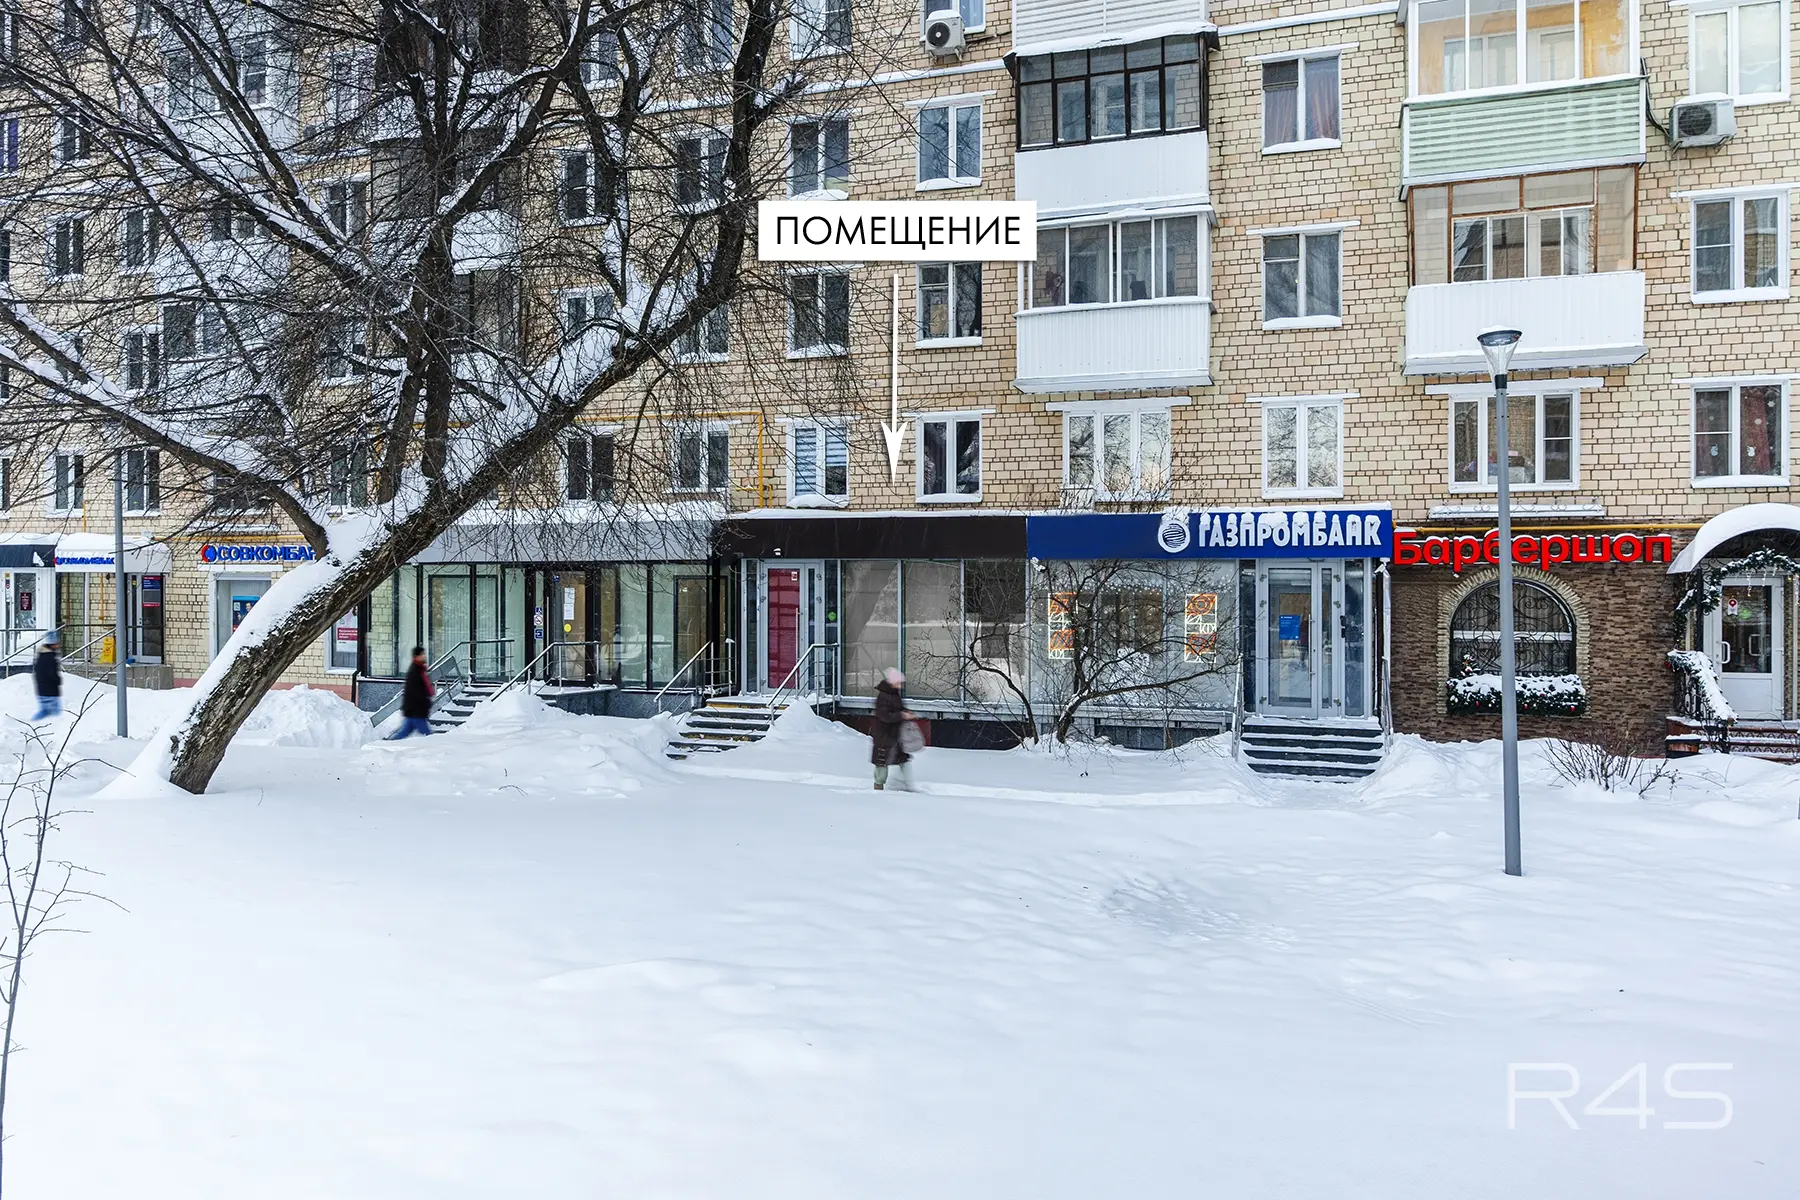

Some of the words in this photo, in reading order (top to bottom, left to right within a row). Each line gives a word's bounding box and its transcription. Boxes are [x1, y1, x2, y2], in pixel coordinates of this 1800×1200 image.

[1198, 514, 1382, 547] ГАЗПРОМБАНК
[218, 545, 317, 561] СОВКОМБАН
[1393, 531, 1672, 572] Барбершоп
